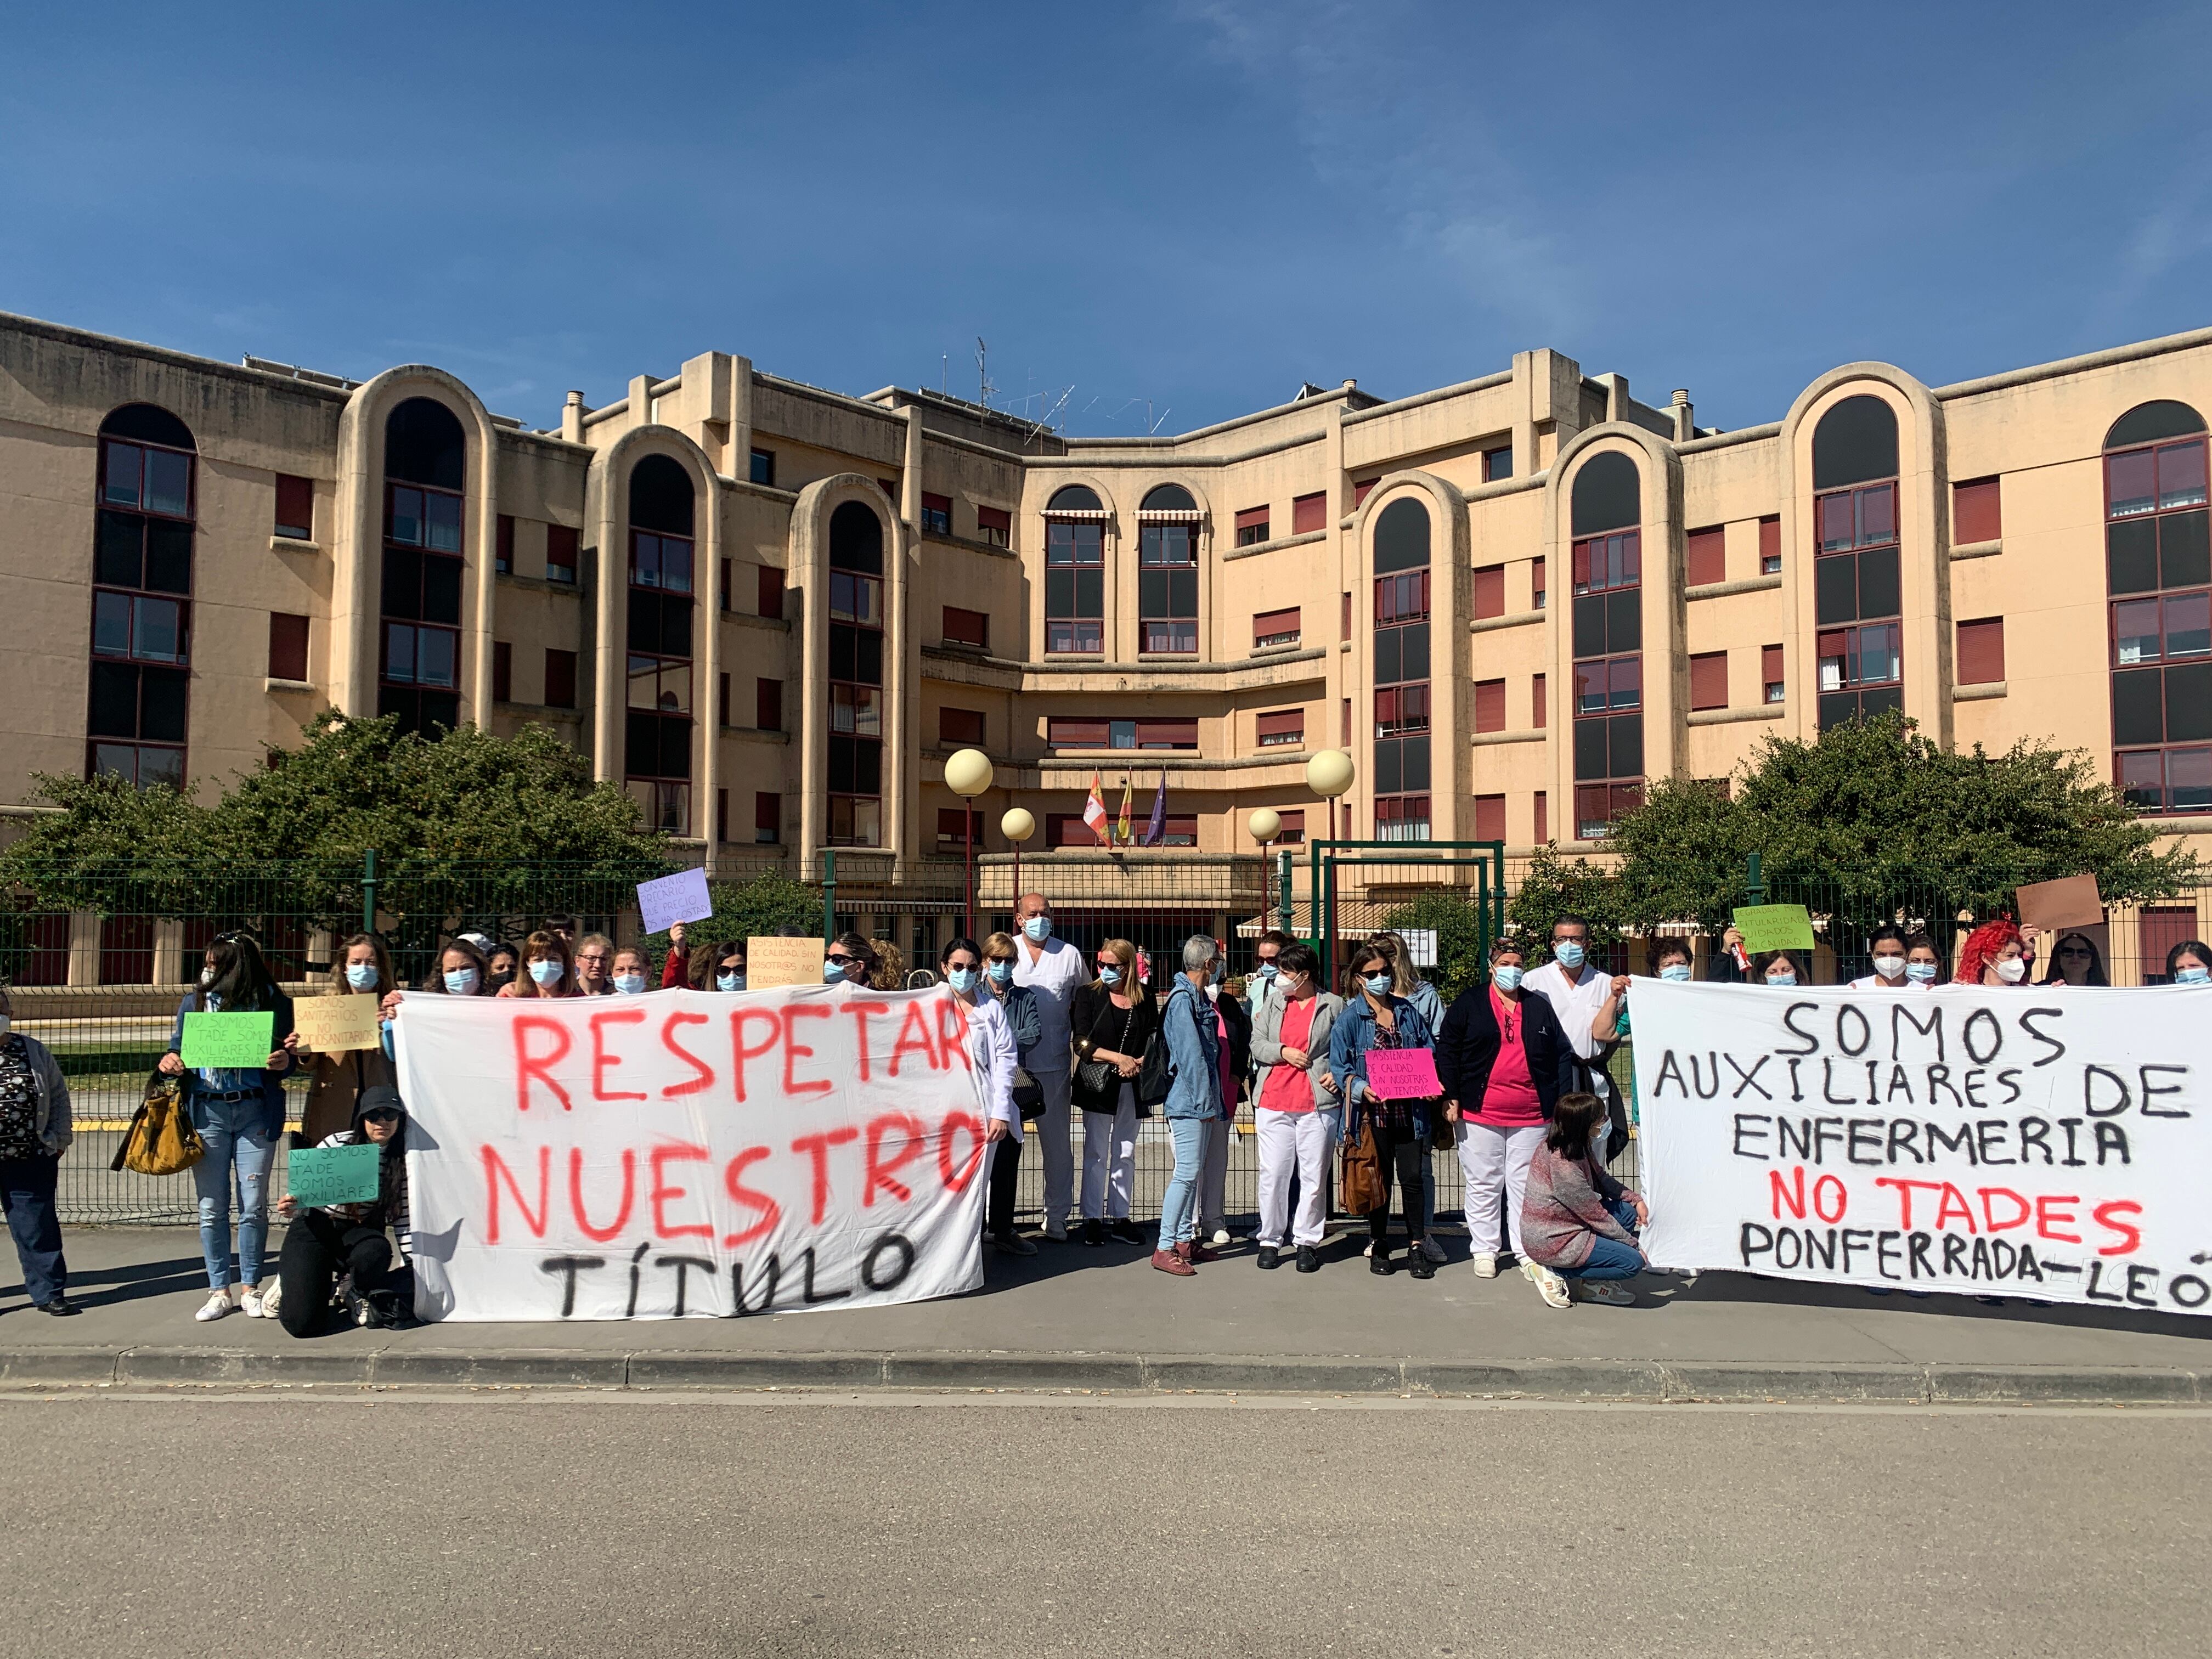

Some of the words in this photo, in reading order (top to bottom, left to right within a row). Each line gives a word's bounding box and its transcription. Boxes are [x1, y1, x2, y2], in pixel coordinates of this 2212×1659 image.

[641, 885, 685, 905] PRECARIO
[663, 895, 696, 911] PRECIO
[1735, 906, 1779, 917] DEGRADAR
[647, 920, 657, 929] OS
[662, 916, 673, 924] HA
[750, 938, 806, 947] ASISTENCIA
[1761, 938, 1801, 948] CALIDAD
[749, 961, 797, 970] NOSOTR@S
[308, 997, 346, 1008] SOMOS
[185, 1015, 203, 1028] NO
[208, 1015, 255, 1028] SOMOS
[296, 1009, 358, 1021] SANITARIOS
[317, 1023, 331, 1032] NO
[1774, 1002, 2067, 1067] SOMOS
[182, 1044, 251, 1056] AUXILIARES
[257, 1043, 268, 1055] DE
[512, 998, 973, 1112] RESPETAR
[1373, 1051, 1413, 1060] ASISTENCIA
[1368, 1064, 1376, 1074] DE
[1381, 1063, 1413, 1073] CALIDAD
[1373, 1076, 1385, 1085] SIN
[1391, 1074, 1428, 1085] NOSOTRAS
[1654, 1049, 2023, 1108] AUXILIARES
[2085, 1063, 2191, 1118] DE
[1380, 1087, 1391, 1096] NO
[1734, 1113, 2132, 1166] ENFERMERIA
[290, 1149, 309, 1161] NO
[321, 1146, 368, 1159] SOMOS
[291, 1163, 334, 1175] TADE
[290, 1176, 344, 1190] SOMOS
[481, 1110, 987, 1248] NUESTRO
[1770, 1165, 1847, 1224] NO
[1876, 1177, 2143, 1256] TADES
[541, 1232, 916, 1318] TÍTULO
